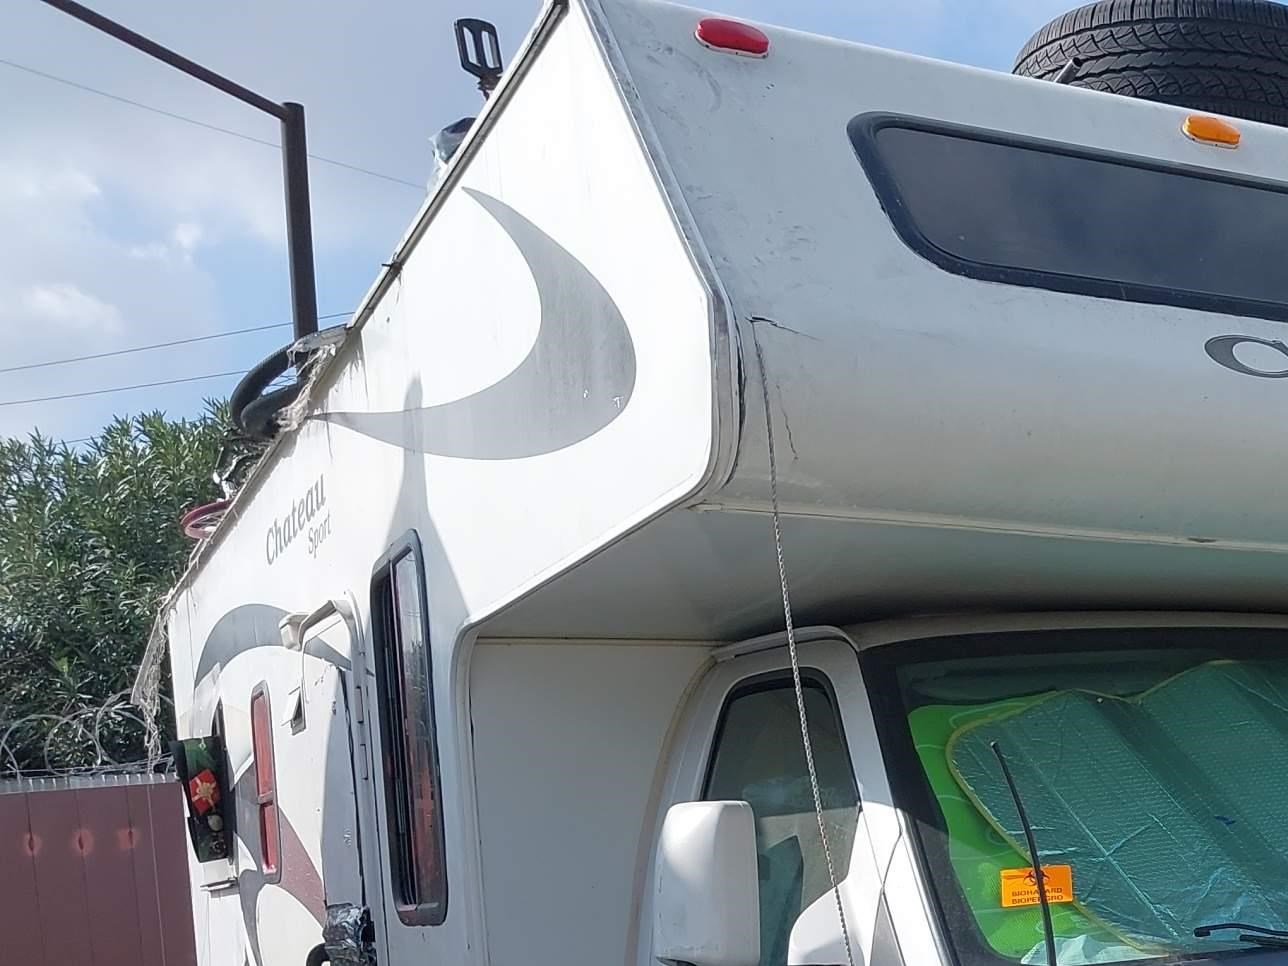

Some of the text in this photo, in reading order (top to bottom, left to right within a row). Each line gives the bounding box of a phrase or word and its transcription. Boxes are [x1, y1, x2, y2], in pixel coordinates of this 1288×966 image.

[266, 474, 326, 565] Chateau
[308, 509, 331, 558] Sport
[1012, 887, 1063, 896] BIOHAARD
